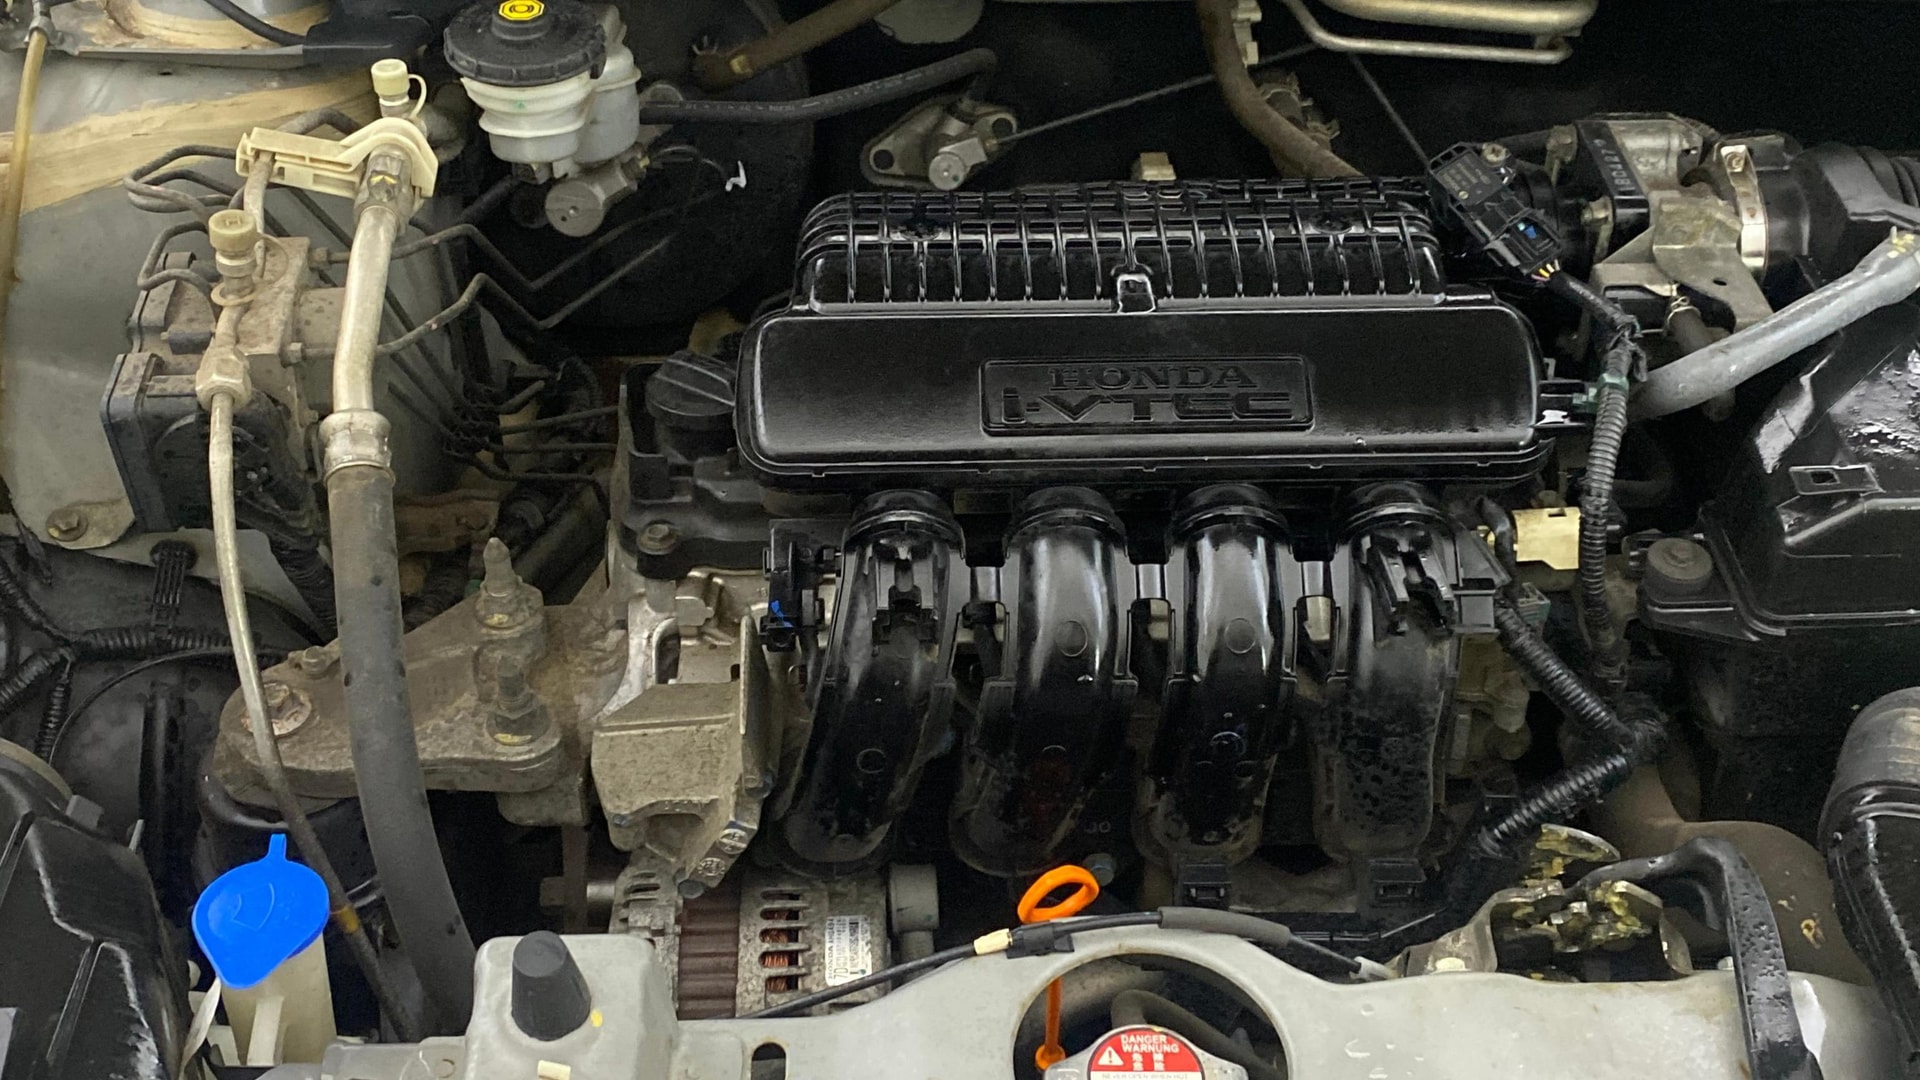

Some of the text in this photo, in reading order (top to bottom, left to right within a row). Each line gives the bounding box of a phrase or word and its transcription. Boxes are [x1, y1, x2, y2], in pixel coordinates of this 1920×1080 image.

[1050, 366, 1258, 390] HONDA
[1002, 387, 1295, 424] i-VTEC
[1121, 1035, 1167, 1044] DANGER
[1122, 1043, 1180, 1053] WARNUNG
